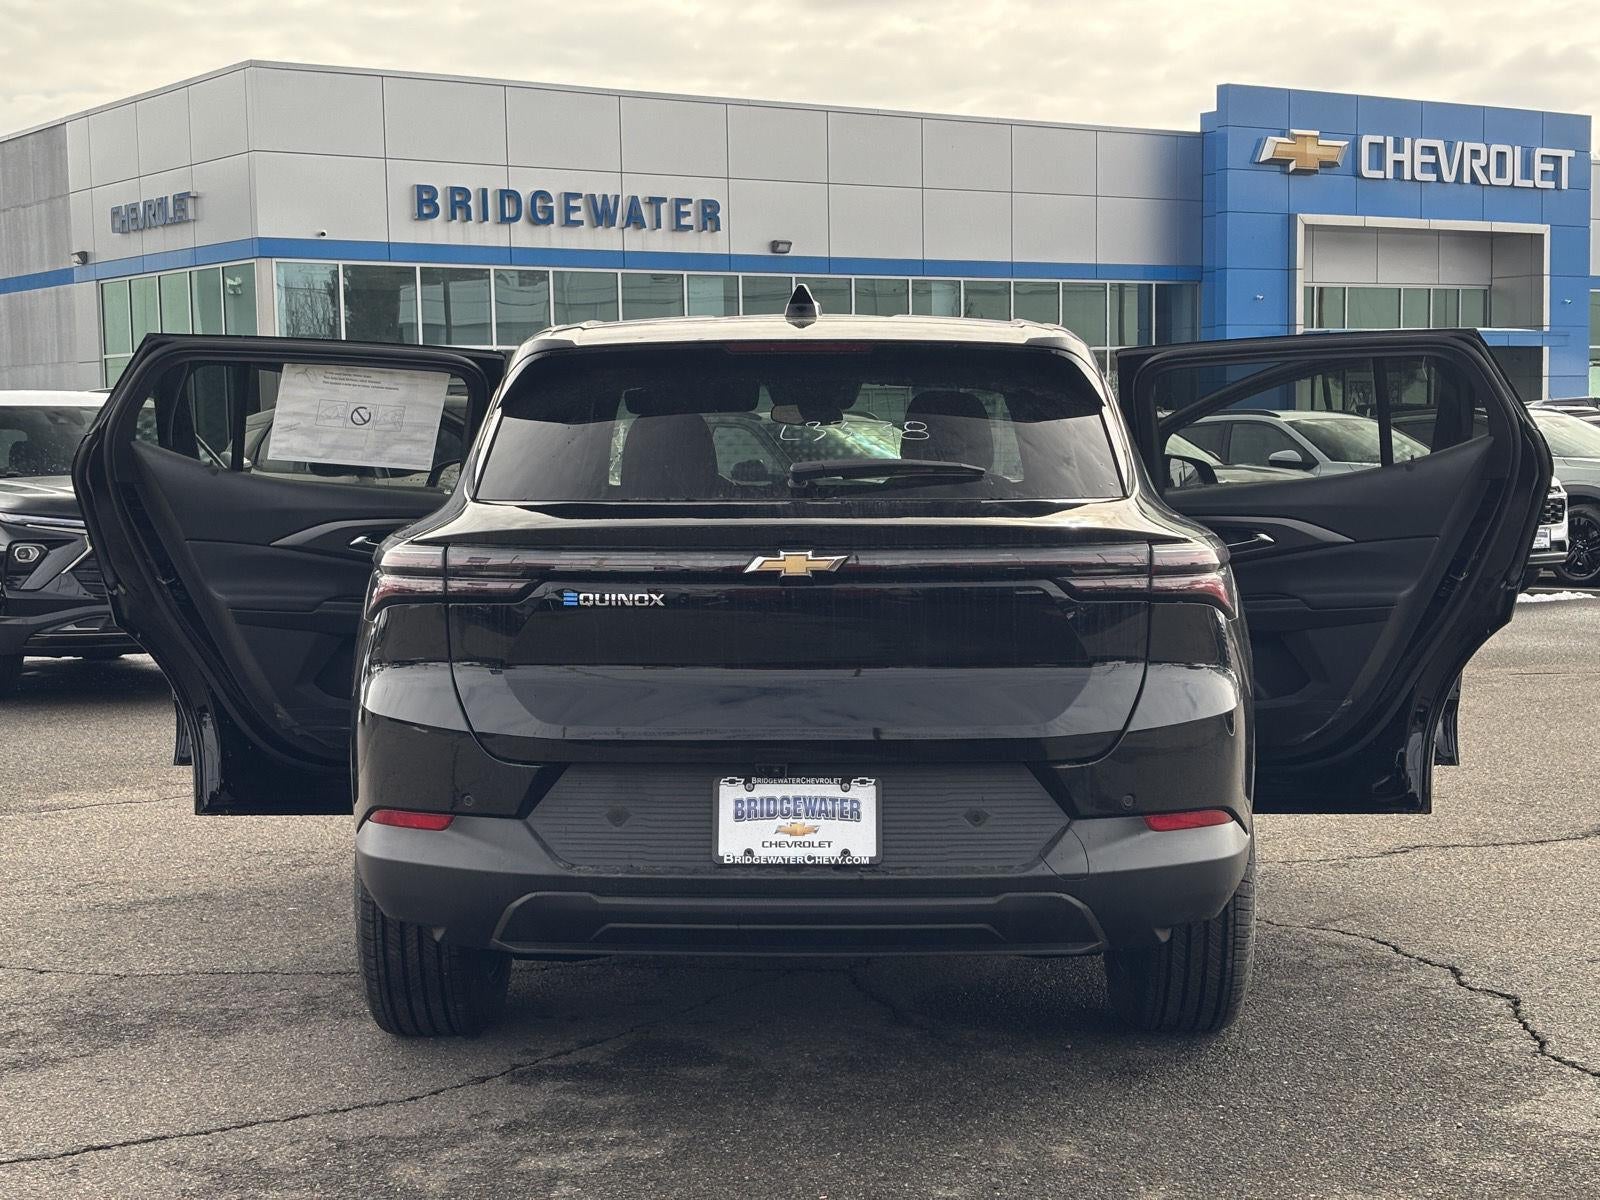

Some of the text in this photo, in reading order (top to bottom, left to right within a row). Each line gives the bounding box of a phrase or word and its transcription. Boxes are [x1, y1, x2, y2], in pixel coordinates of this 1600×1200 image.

[1360, 134, 1576, 190] CHEVROLET
[110, 190, 198, 234] CHEVROLET
[413, 183, 721, 232] BRIDGEWATER
[563, 592, 665, 607] EQUINOX
[733, 795, 862, 822] BRIDGEWATER
[761, 840, 833, 849] CHEVROLET
